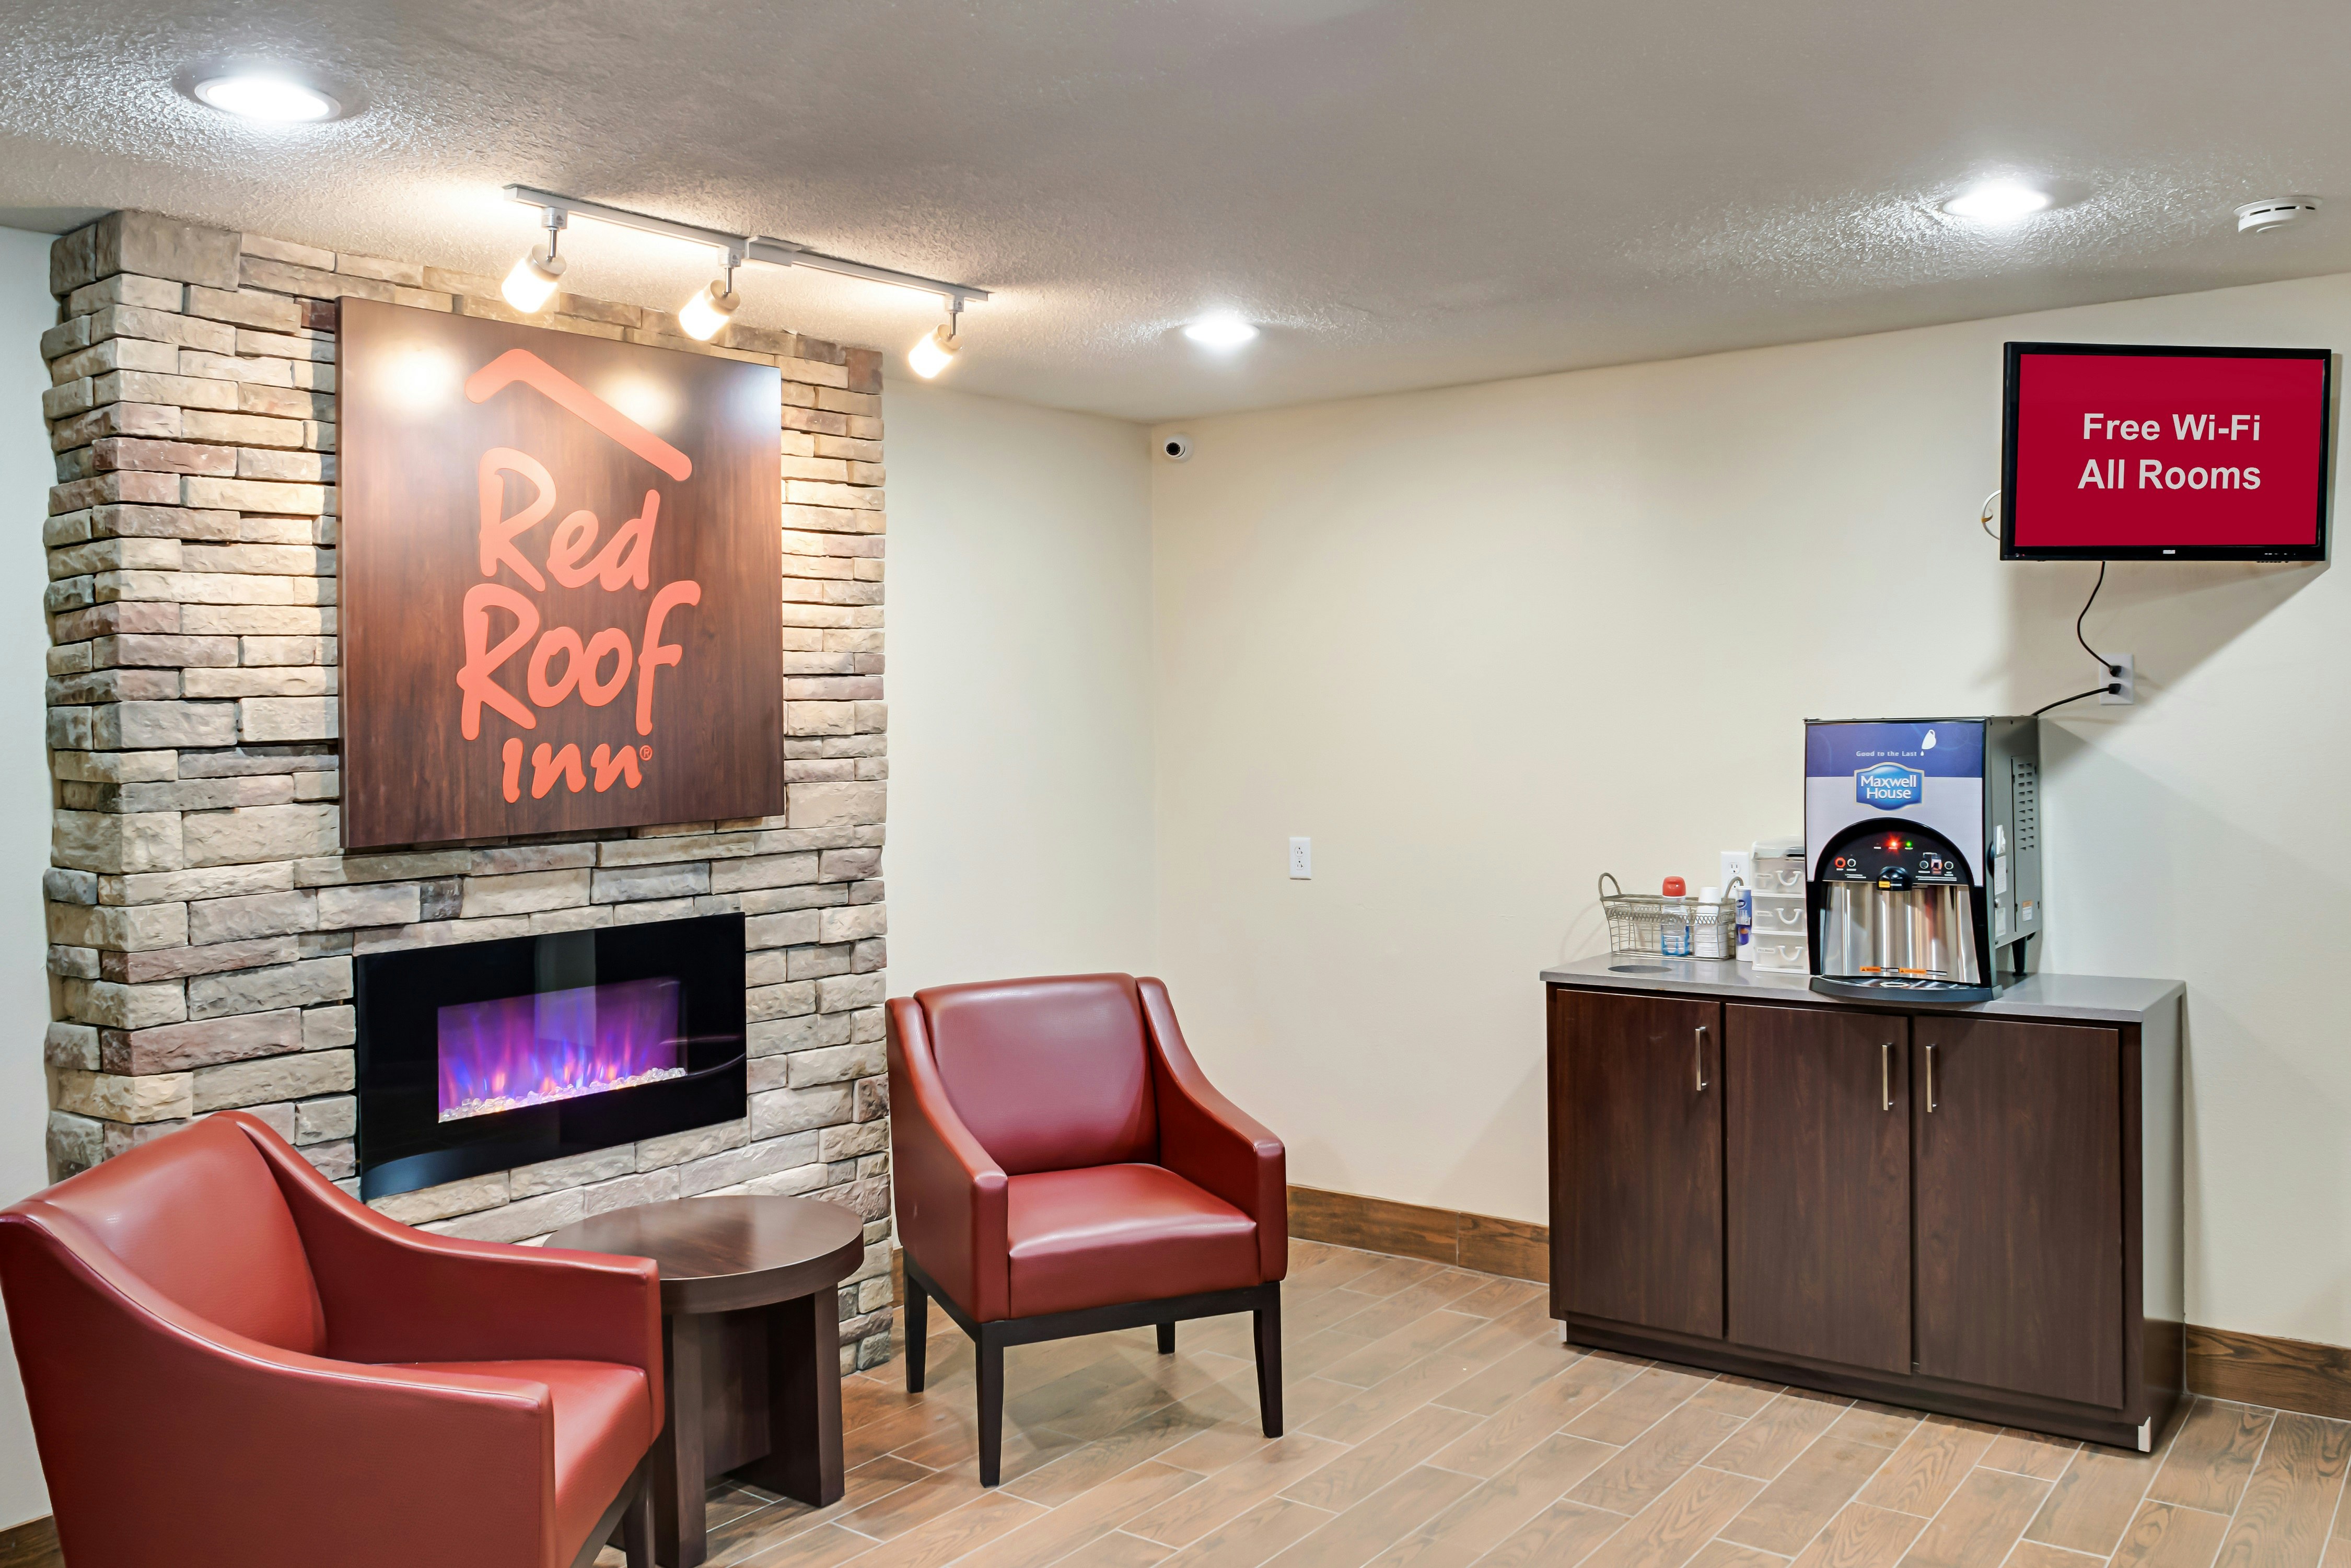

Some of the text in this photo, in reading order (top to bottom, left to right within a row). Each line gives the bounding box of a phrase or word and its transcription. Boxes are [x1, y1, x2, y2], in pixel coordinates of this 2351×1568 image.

[2084, 413, 2260, 440] Free Wi-Fi
[2077, 459, 2261, 490] All Rooms
[478, 447, 660, 593] Red
[456, 580, 701, 741] Roof
[1860, 774, 1917, 788] Maxwell
[1866, 787, 1912, 799] House
